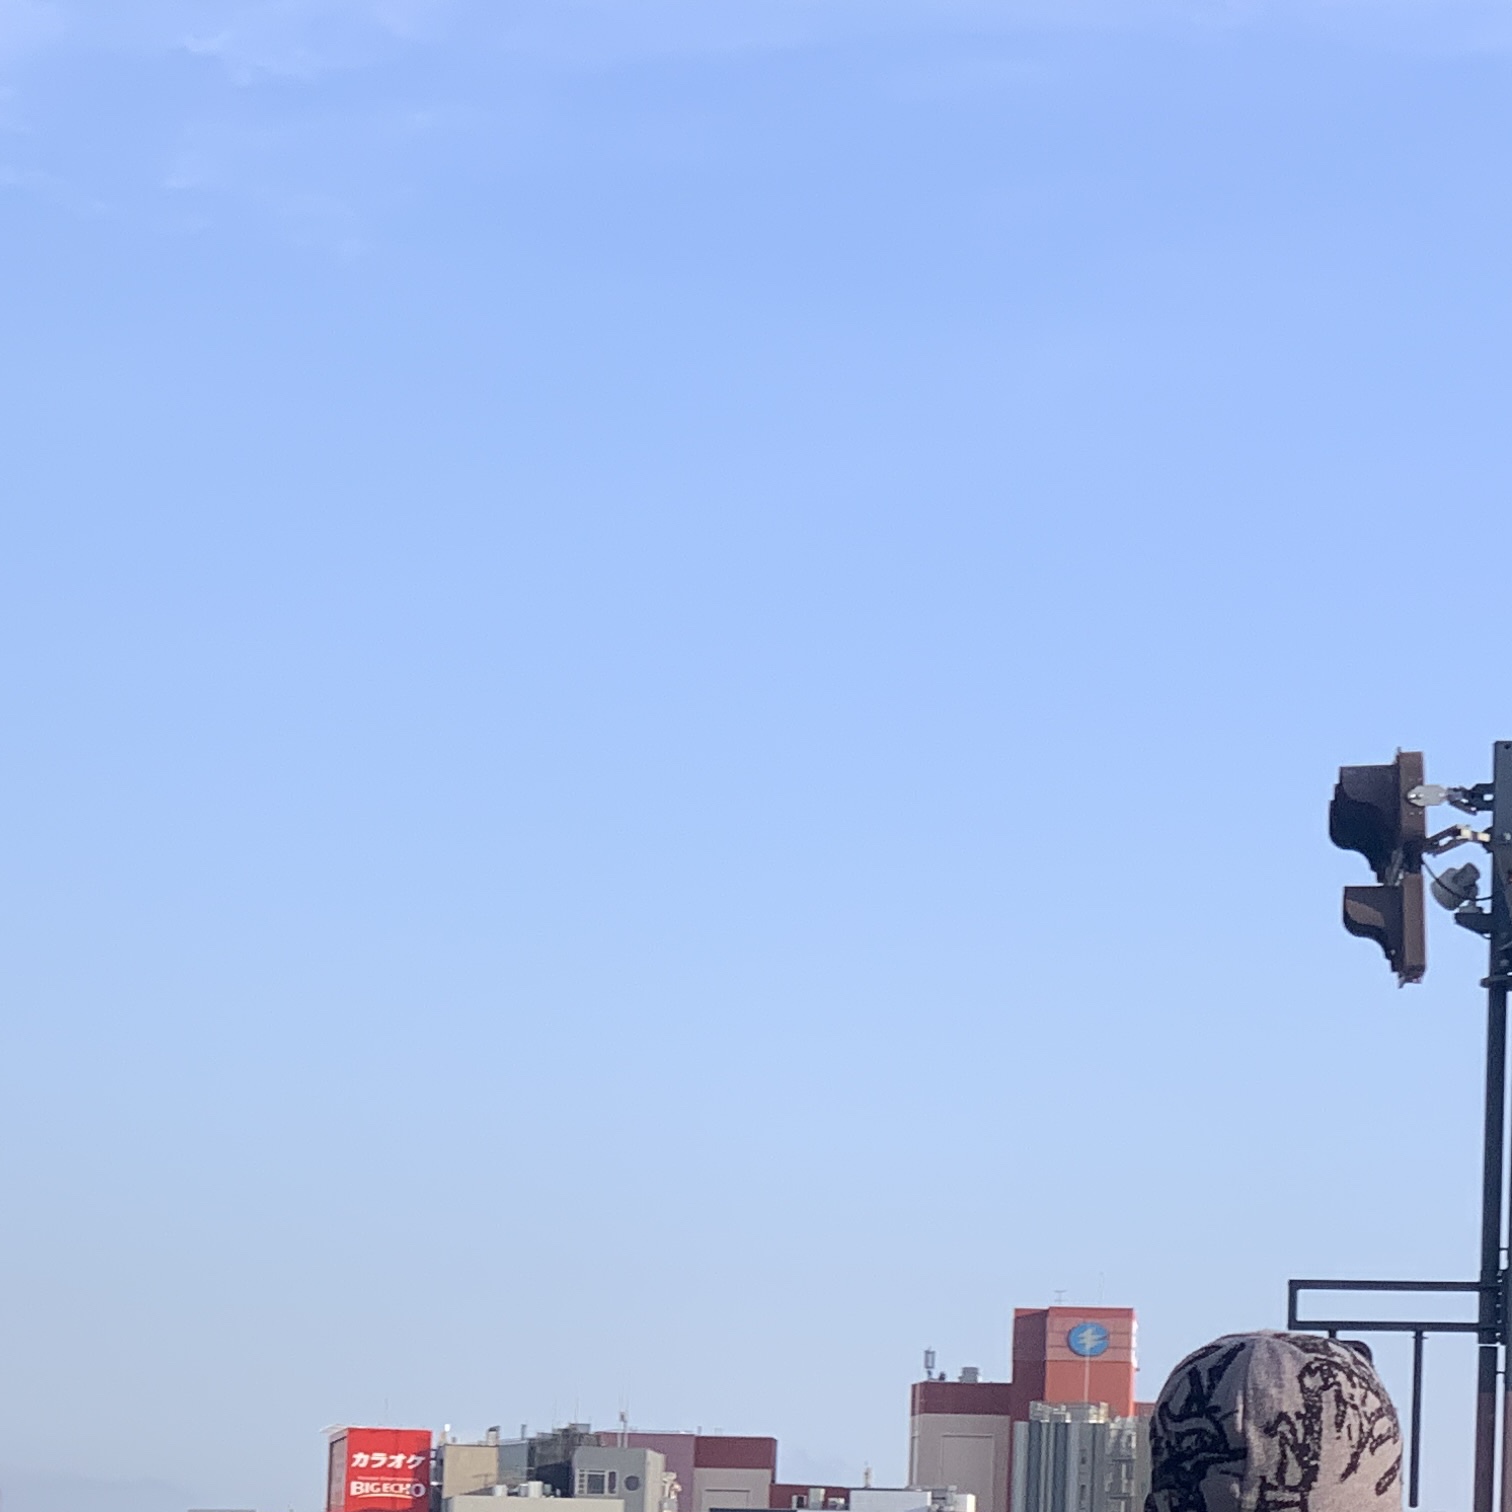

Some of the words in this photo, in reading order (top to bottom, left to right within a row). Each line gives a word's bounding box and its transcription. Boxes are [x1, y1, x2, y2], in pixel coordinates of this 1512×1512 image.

[351, 1452, 426, 1469] カラオケ
[350, 1481, 380, 1496] BIG
[382, 1482, 426, 1498] ECHO
